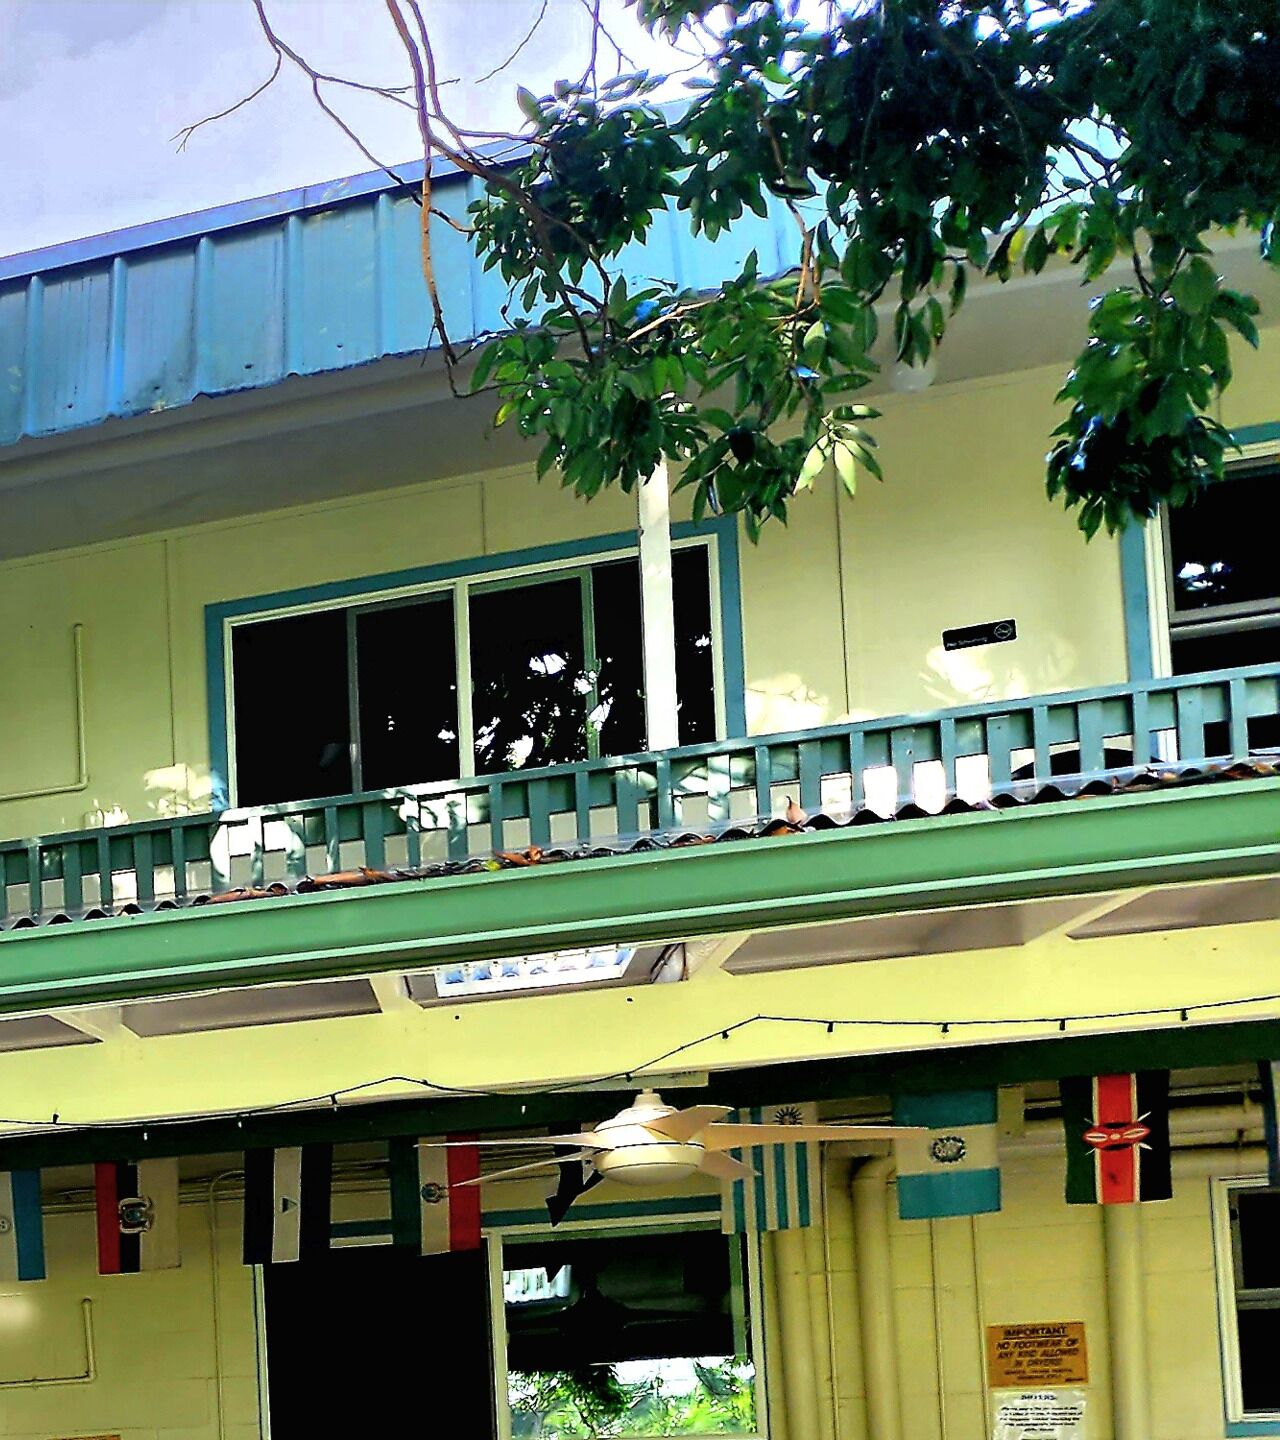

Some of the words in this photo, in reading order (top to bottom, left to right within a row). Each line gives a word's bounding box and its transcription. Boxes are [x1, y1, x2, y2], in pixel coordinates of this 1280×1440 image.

[1003, 1326, 1067, 1336] IMPORTANT
[997, 1341, 1010, 1350] NO
[1013, 1339, 1063, 1349] FOOTWEAR
[1066, 1338, 1079, 1347] OF
[1039, 1347, 1080, 1357] ALLOWED
